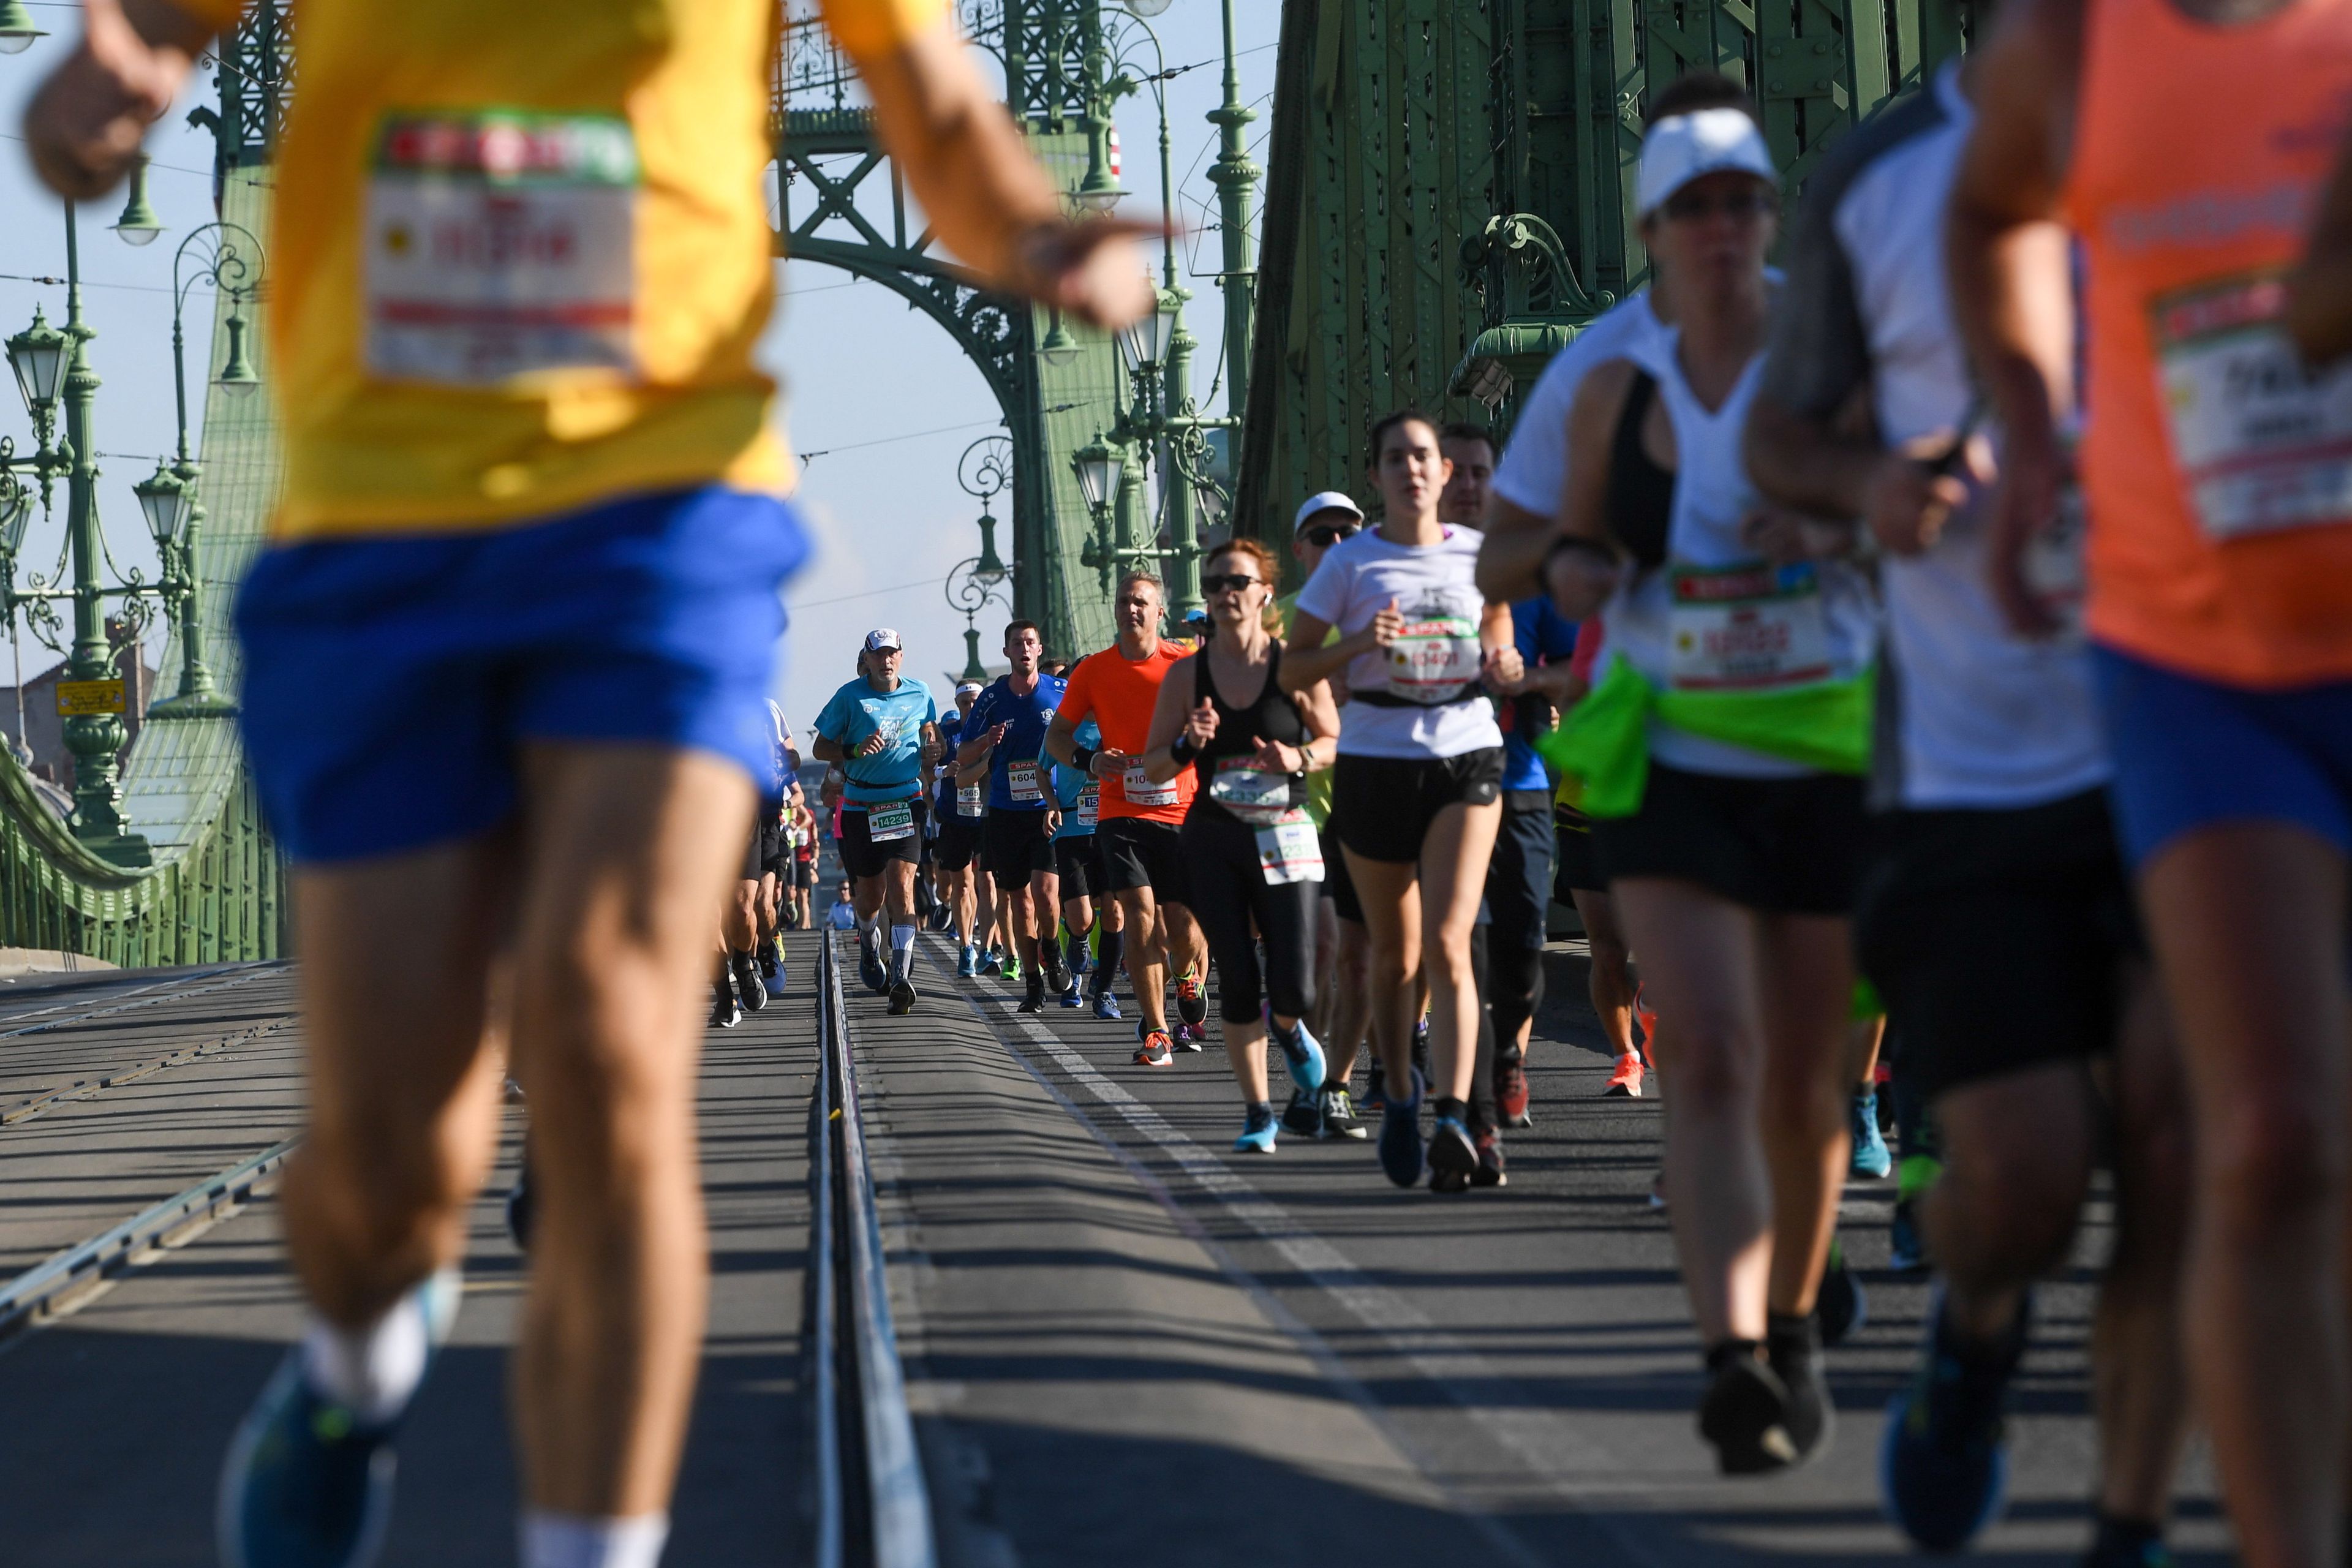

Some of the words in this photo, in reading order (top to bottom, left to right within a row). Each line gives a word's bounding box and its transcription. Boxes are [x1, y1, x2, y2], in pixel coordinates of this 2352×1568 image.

[1041, 709, 1056, 718] TSV
[1088, 798, 1099, 807] 15
[875, 803, 898, 812] SPAR
[879, 815, 909, 827] 14239
